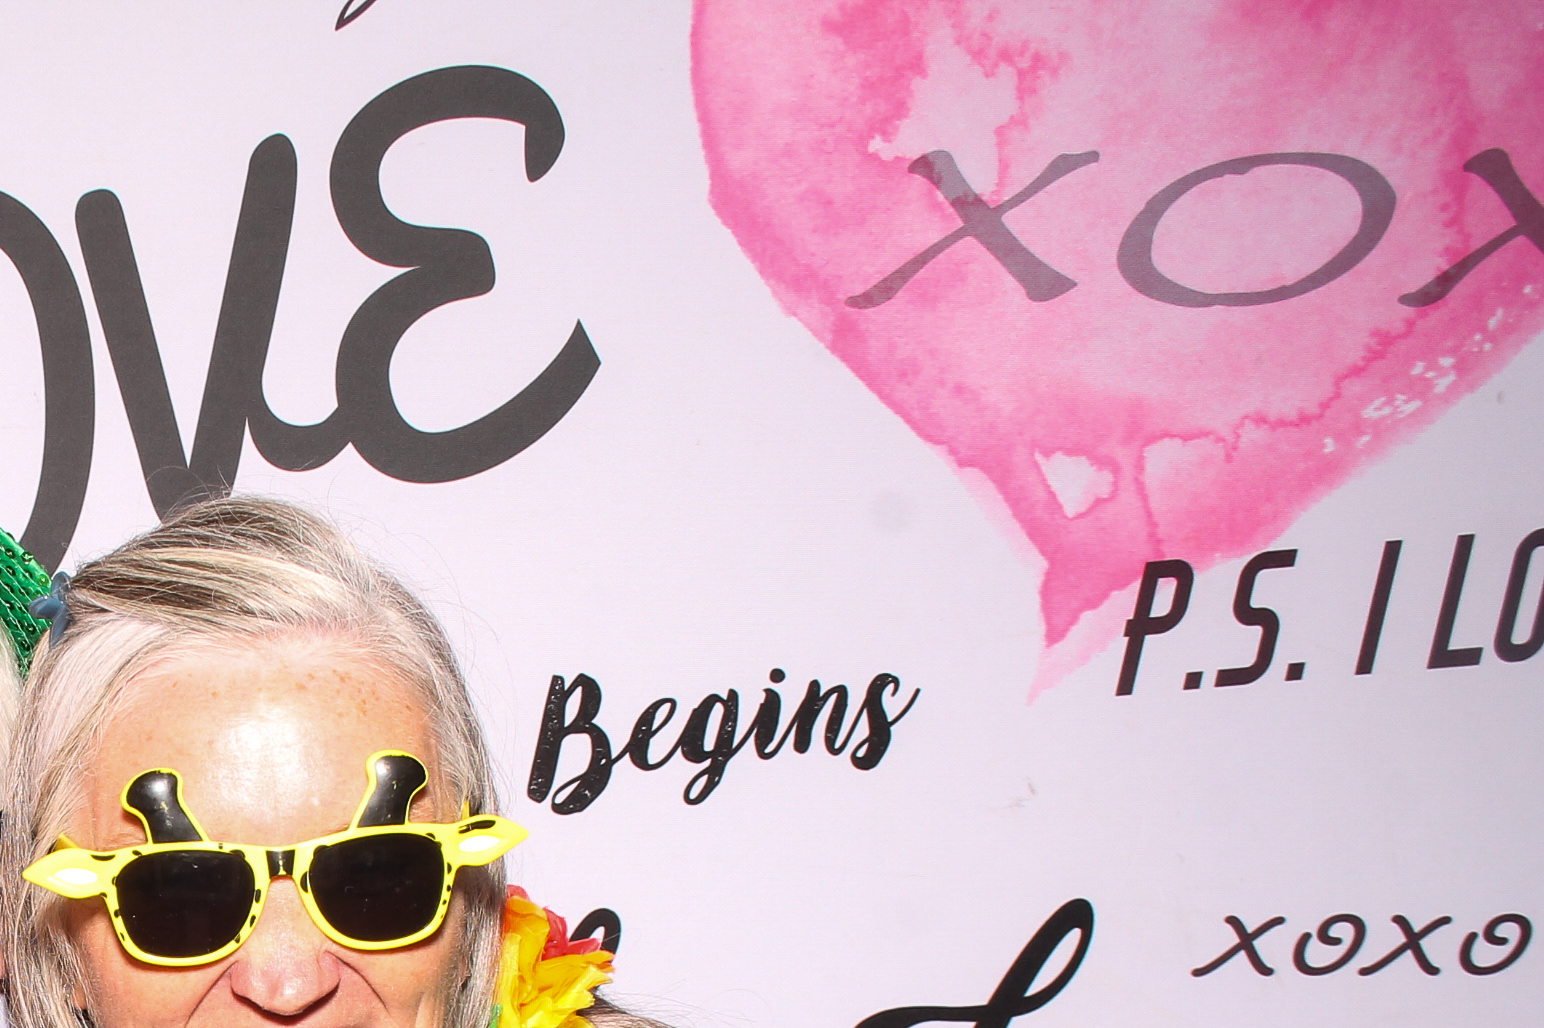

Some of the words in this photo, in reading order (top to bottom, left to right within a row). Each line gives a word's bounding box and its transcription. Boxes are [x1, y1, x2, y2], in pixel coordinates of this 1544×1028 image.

[1115, 548, 1306, 697] P.S.
[1355, 539, 1403, 676] I
[526, 668, 921, 816] Begins
